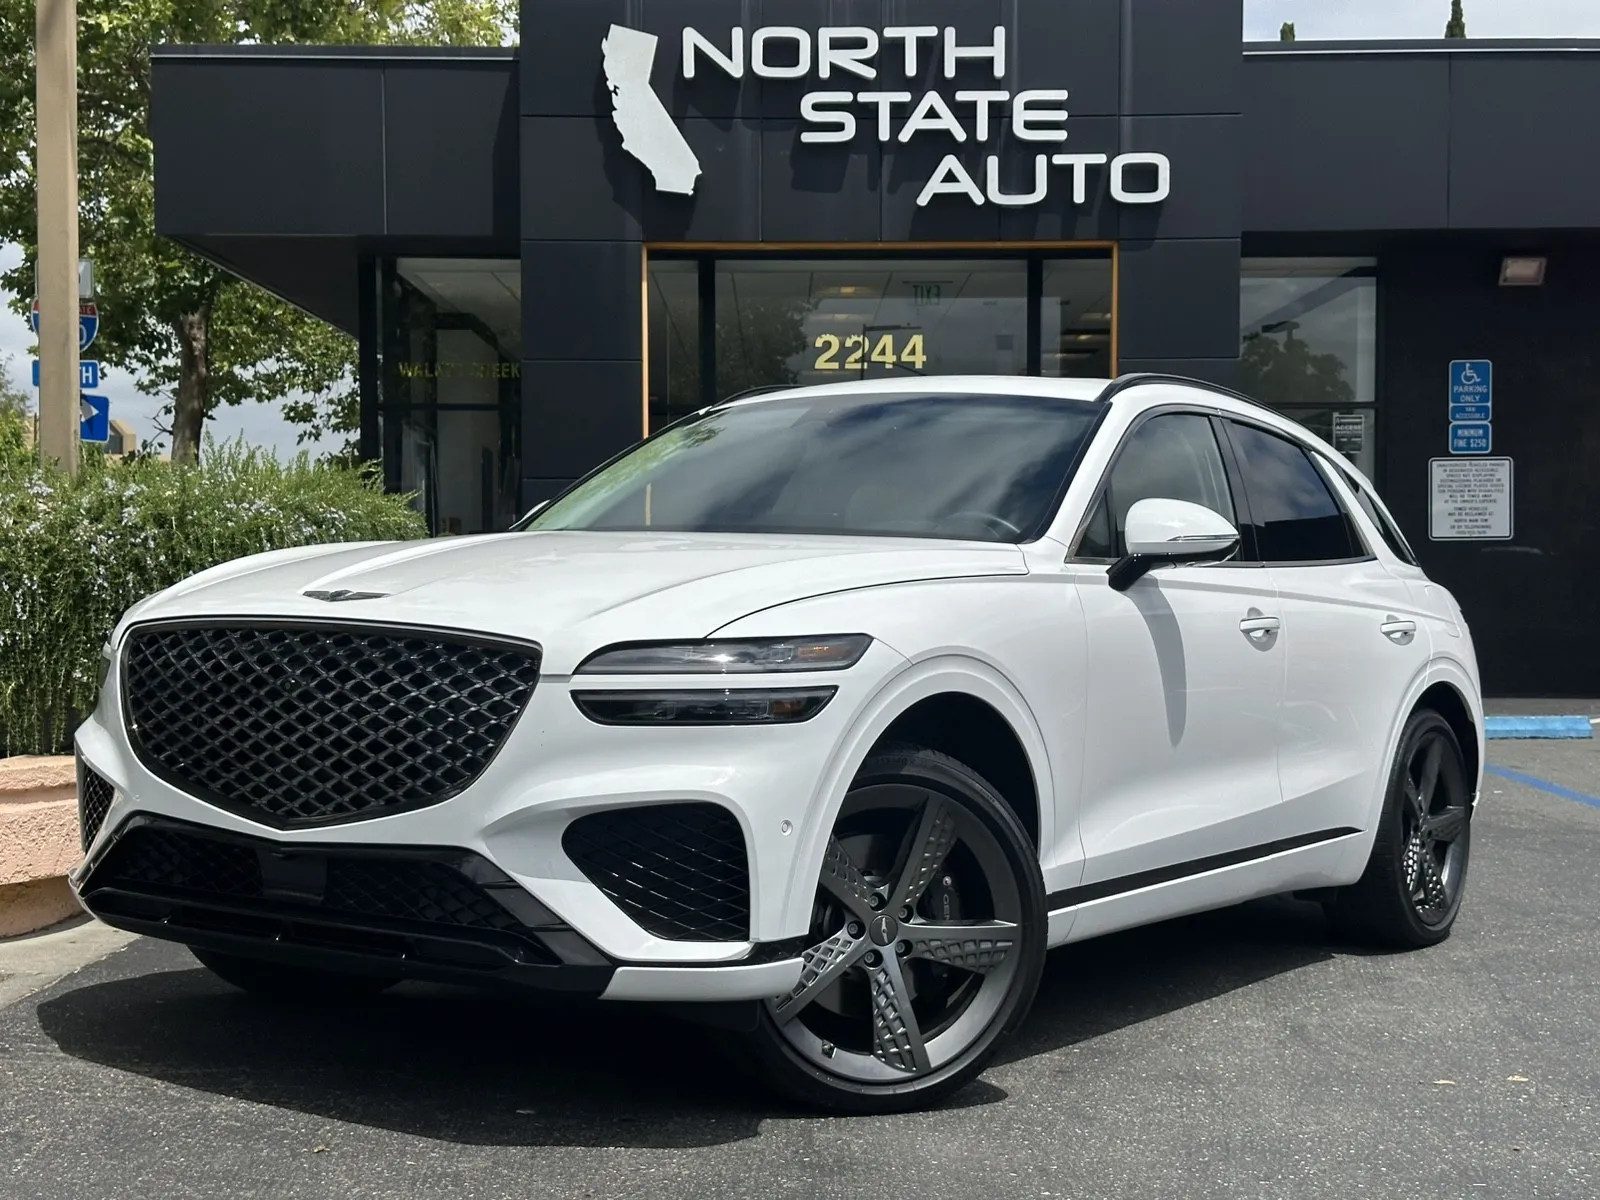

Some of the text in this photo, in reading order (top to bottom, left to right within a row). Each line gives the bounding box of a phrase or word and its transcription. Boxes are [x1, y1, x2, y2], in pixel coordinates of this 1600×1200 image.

[682, 25, 1005, 79] NORTH
[800, 89, 1069, 143] STATE
[916, 152, 1170, 207] AUTO
[814, 333, 927, 370] 2244
[1453, 385, 1488, 393] PARKING
[1460, 394, 1480, 402] ONLY
[1470, 438, 1487, 448] $250
